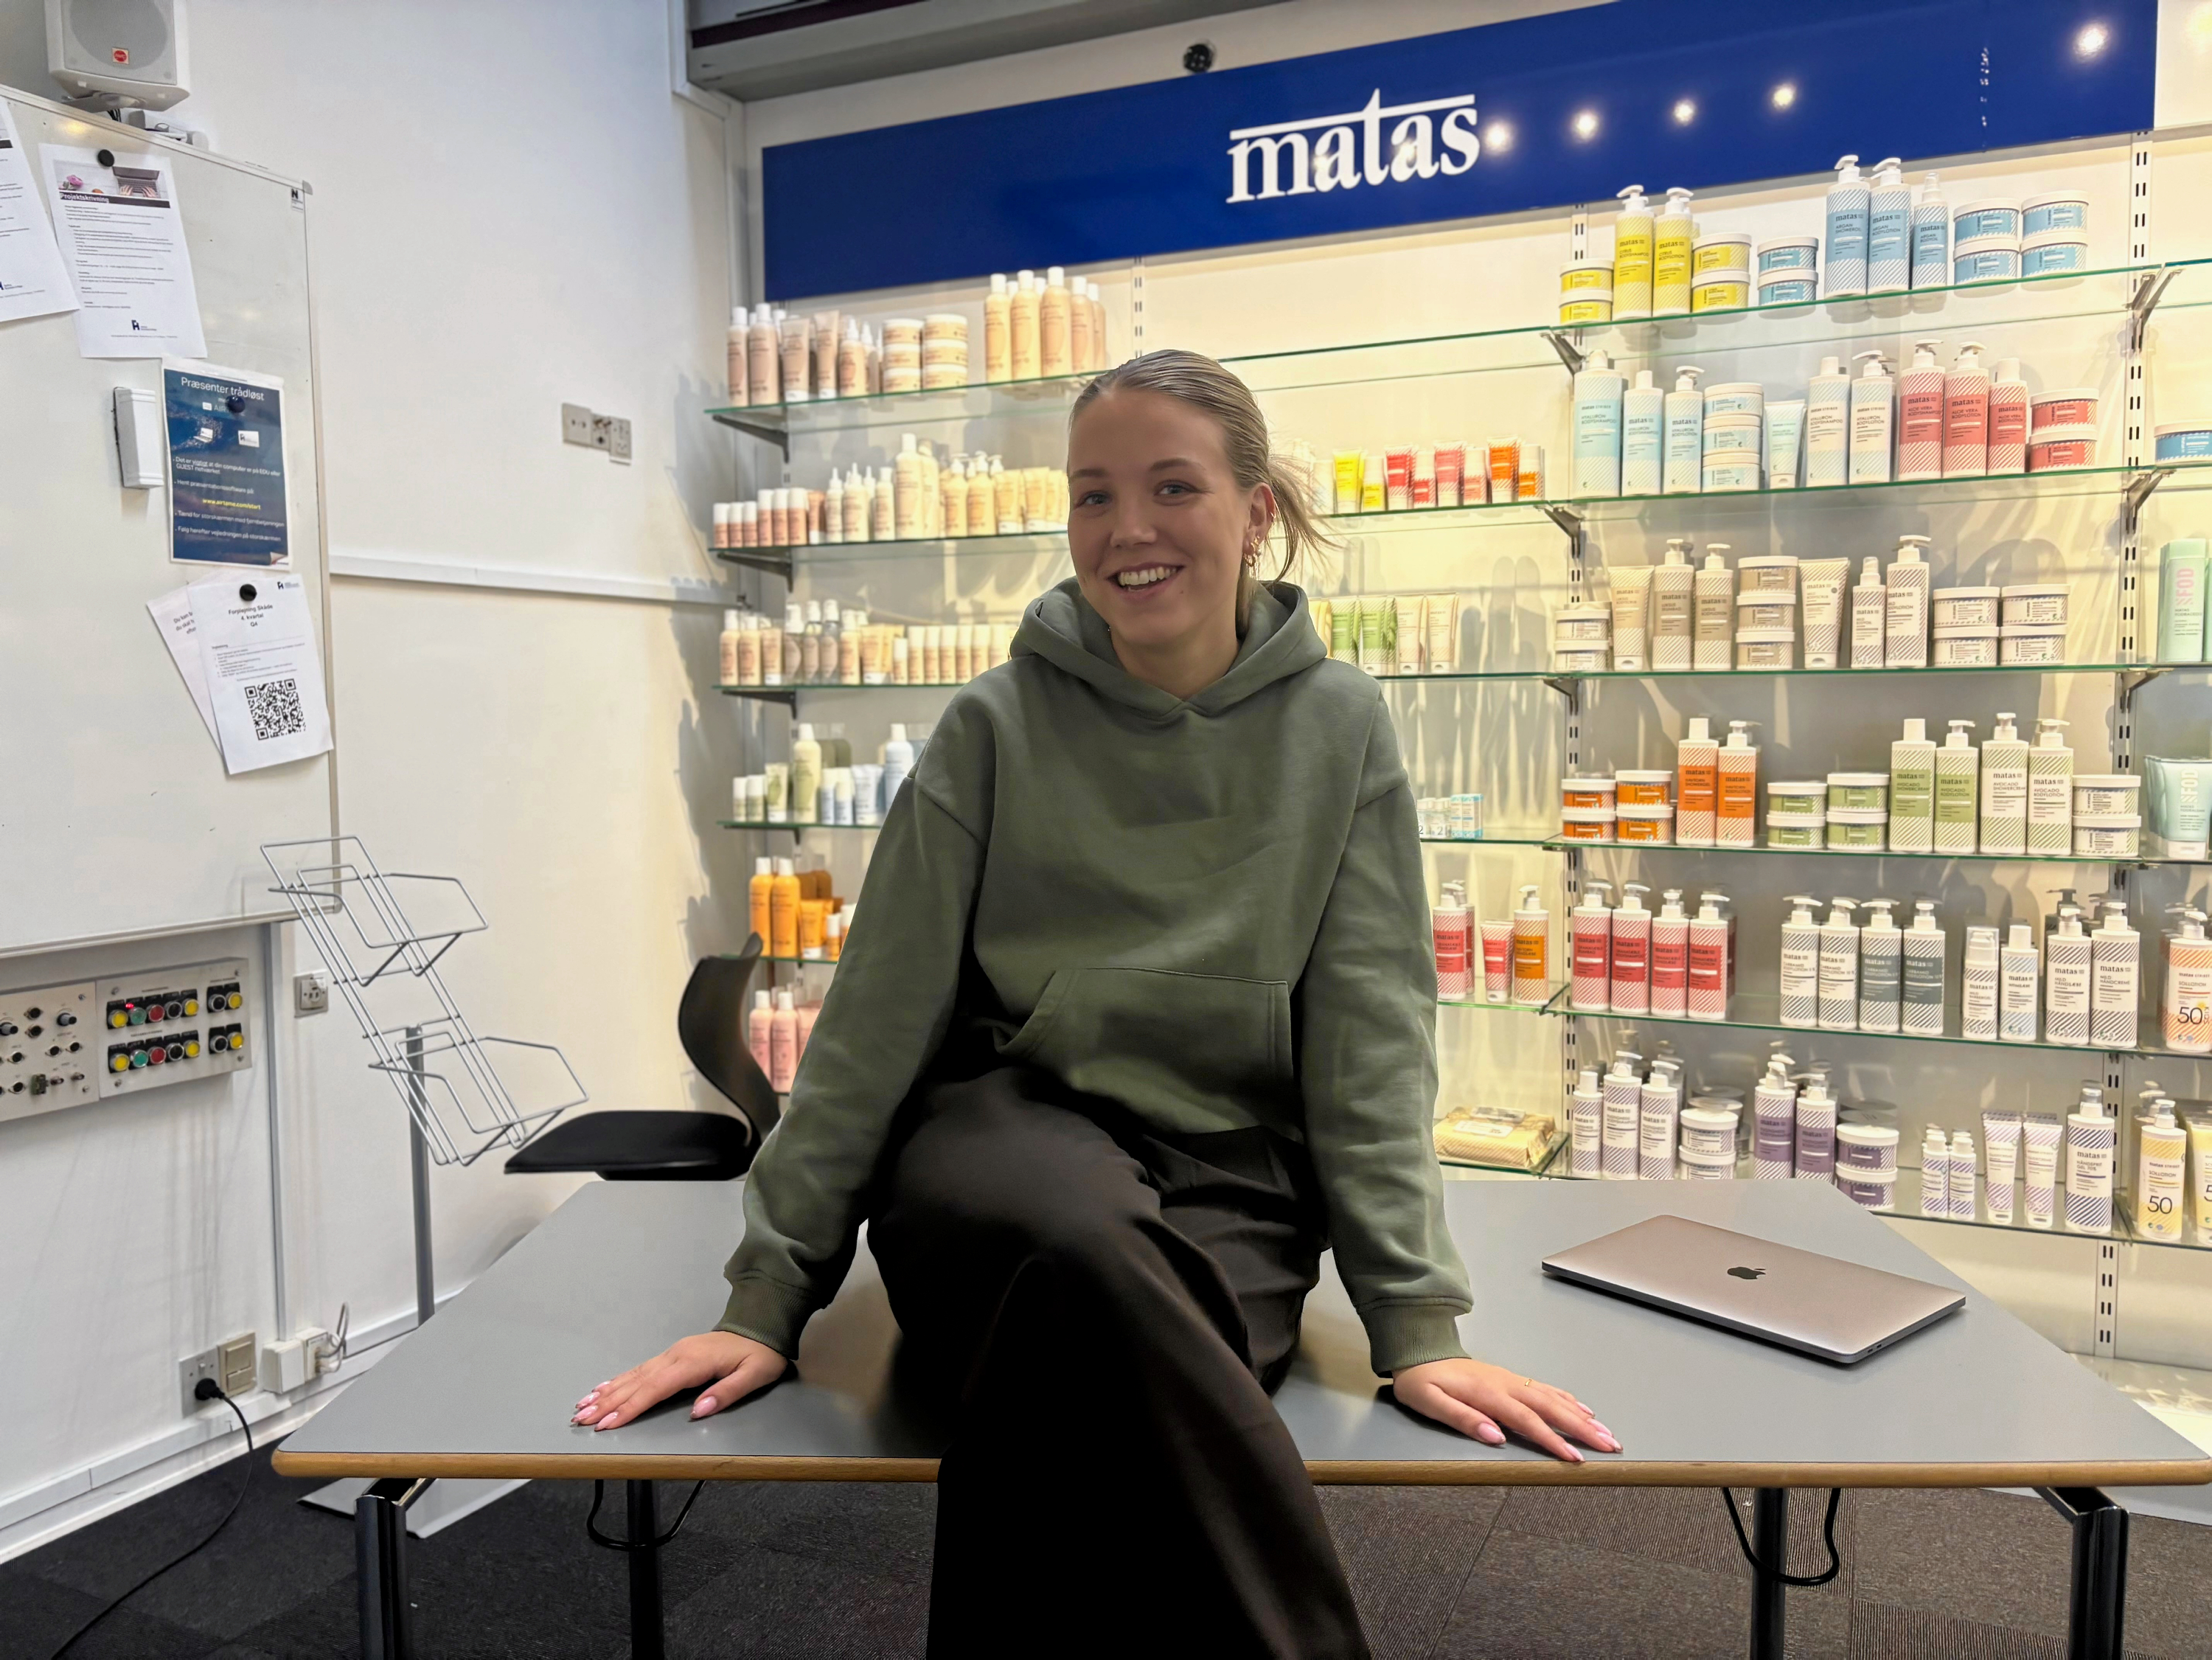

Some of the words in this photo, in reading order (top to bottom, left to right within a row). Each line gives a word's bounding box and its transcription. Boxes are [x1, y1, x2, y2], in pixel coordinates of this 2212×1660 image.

[1226, 88, 1480, 204] matas
[60, 192, 109, 204] Projektskrivning
[1836, 213, 1857, 221] matas
[1873, 215, 1893, 223] matas
[1659, 241, 1677, 249] matas
[181, 377, 229, 393] Præsenter
[231, 387, 264, 400] trådløst
[203, 499, 261, 510] www.airtame.com/start
[1438, 827, 1443, 835] 2
[2177, 1007, 2202, 1024] 50
[2148, 1195, 2172, 1214] 50
